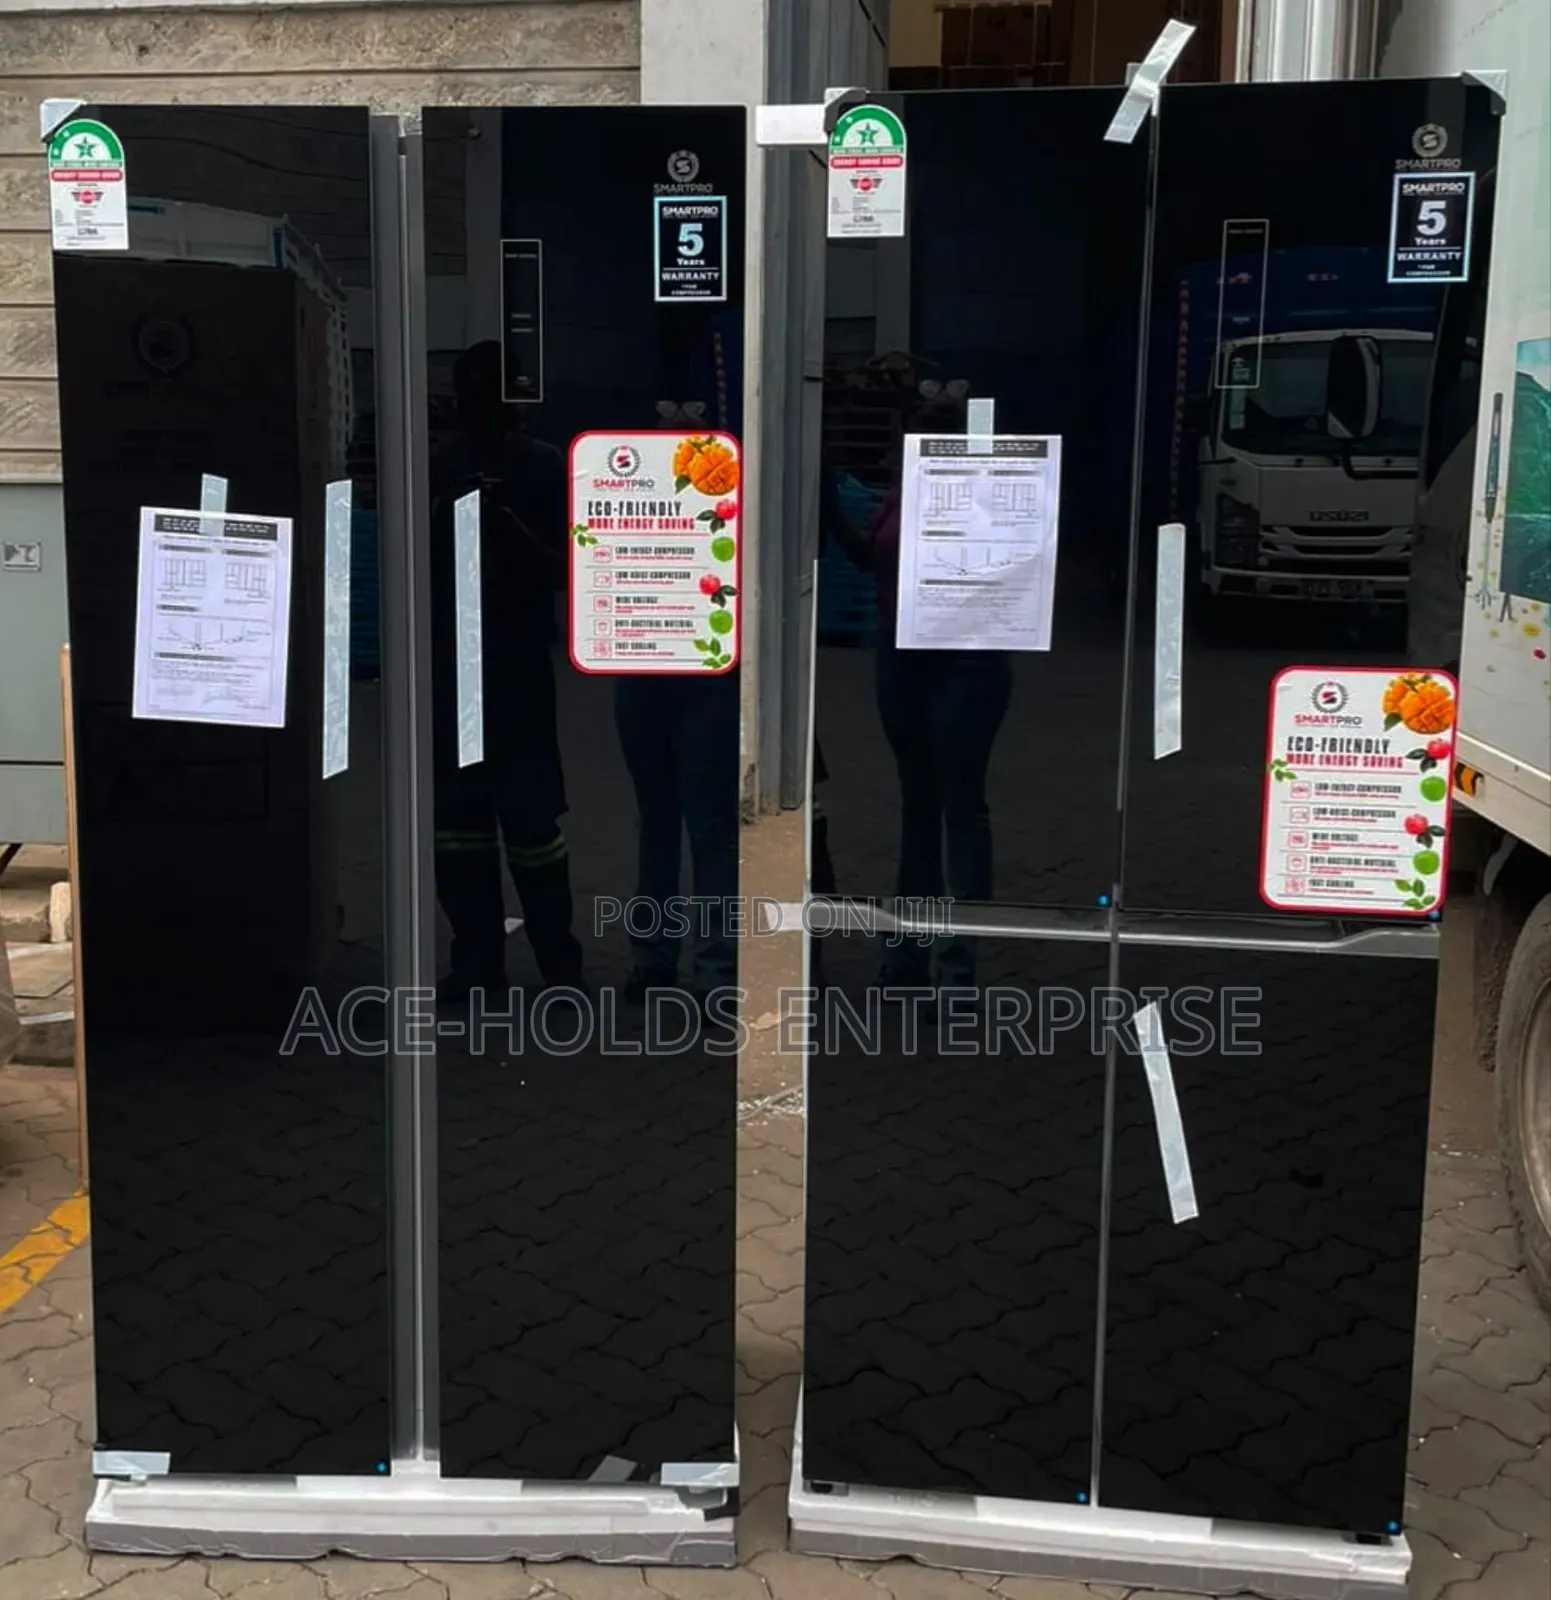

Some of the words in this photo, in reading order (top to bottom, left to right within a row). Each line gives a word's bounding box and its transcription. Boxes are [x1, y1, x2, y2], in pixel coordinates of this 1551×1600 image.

[1395, 158, 1462, 170] SMARTPRO
[653, 183, 714, 194] SMARTPRO
[1402, 182, 1465, 194] SMARTPRO
[662, 206, 719, 216] SMARTPRO
[1416, 200, 1447, 236] 5
[677, 222, 704, 257] 5
[1415, 237, 1446, 246] Years
[1397, 251, 1462, 261] WARRANTY
[677, 258, 706, 266] Years
[661, 272, 720, 281] WARRANTY
[593, 478, 656, 489] SMARTPRO
[587, 500, 682, 517] ECO-FRIENDLY
[587, 518, 615, 531] MORE
[618, 518, 654, 531] ENERGY
[658, 518, 695, 531] SAVING
[1294, 714, 1362, 725] SMARTPRO
[1287, 736, 1390, 755] ECO-FRIENDLY
[1286, 753, 1315, 765] MORE
[1319, 754, 1359, 767] ENERGY
[1363, 756, 1404, 769] SAVING
